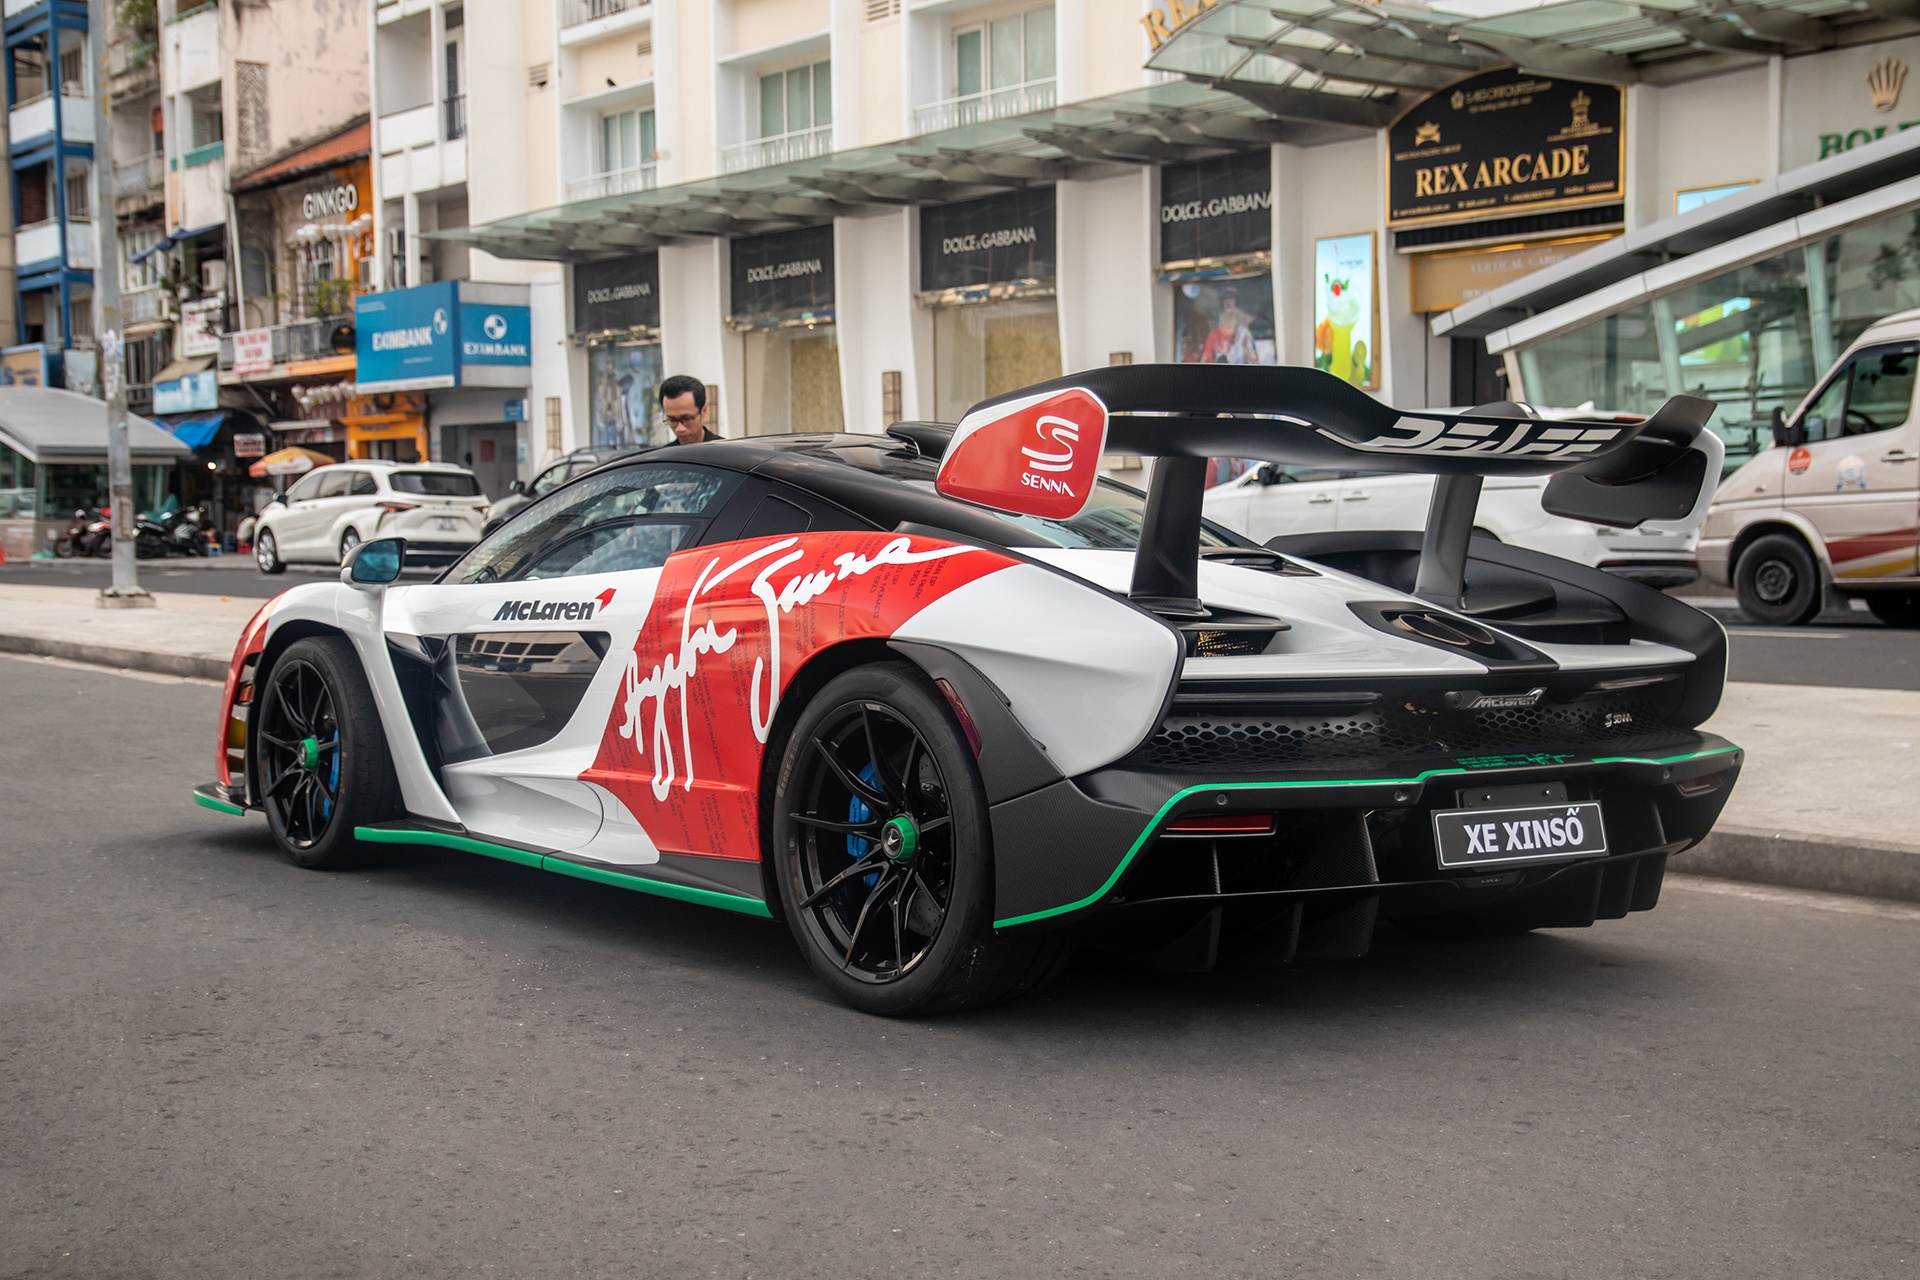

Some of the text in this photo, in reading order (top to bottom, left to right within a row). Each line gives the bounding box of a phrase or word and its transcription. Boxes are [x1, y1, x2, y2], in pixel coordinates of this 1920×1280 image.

[1415, 144, 1591, 198] REX ARCADE
[303, 184, 357, 220] GINKGO
[372, 325, 434, 352] EXIMBANK
[463, 341, 527, 357] EXIMBANK
[1021, 472, 1075, 497] SENNA
[492, 600, 595, 621] McLaren
[1474, 696, 1537, 708] McLaren
[1463, 822, 1499, 855] XE
